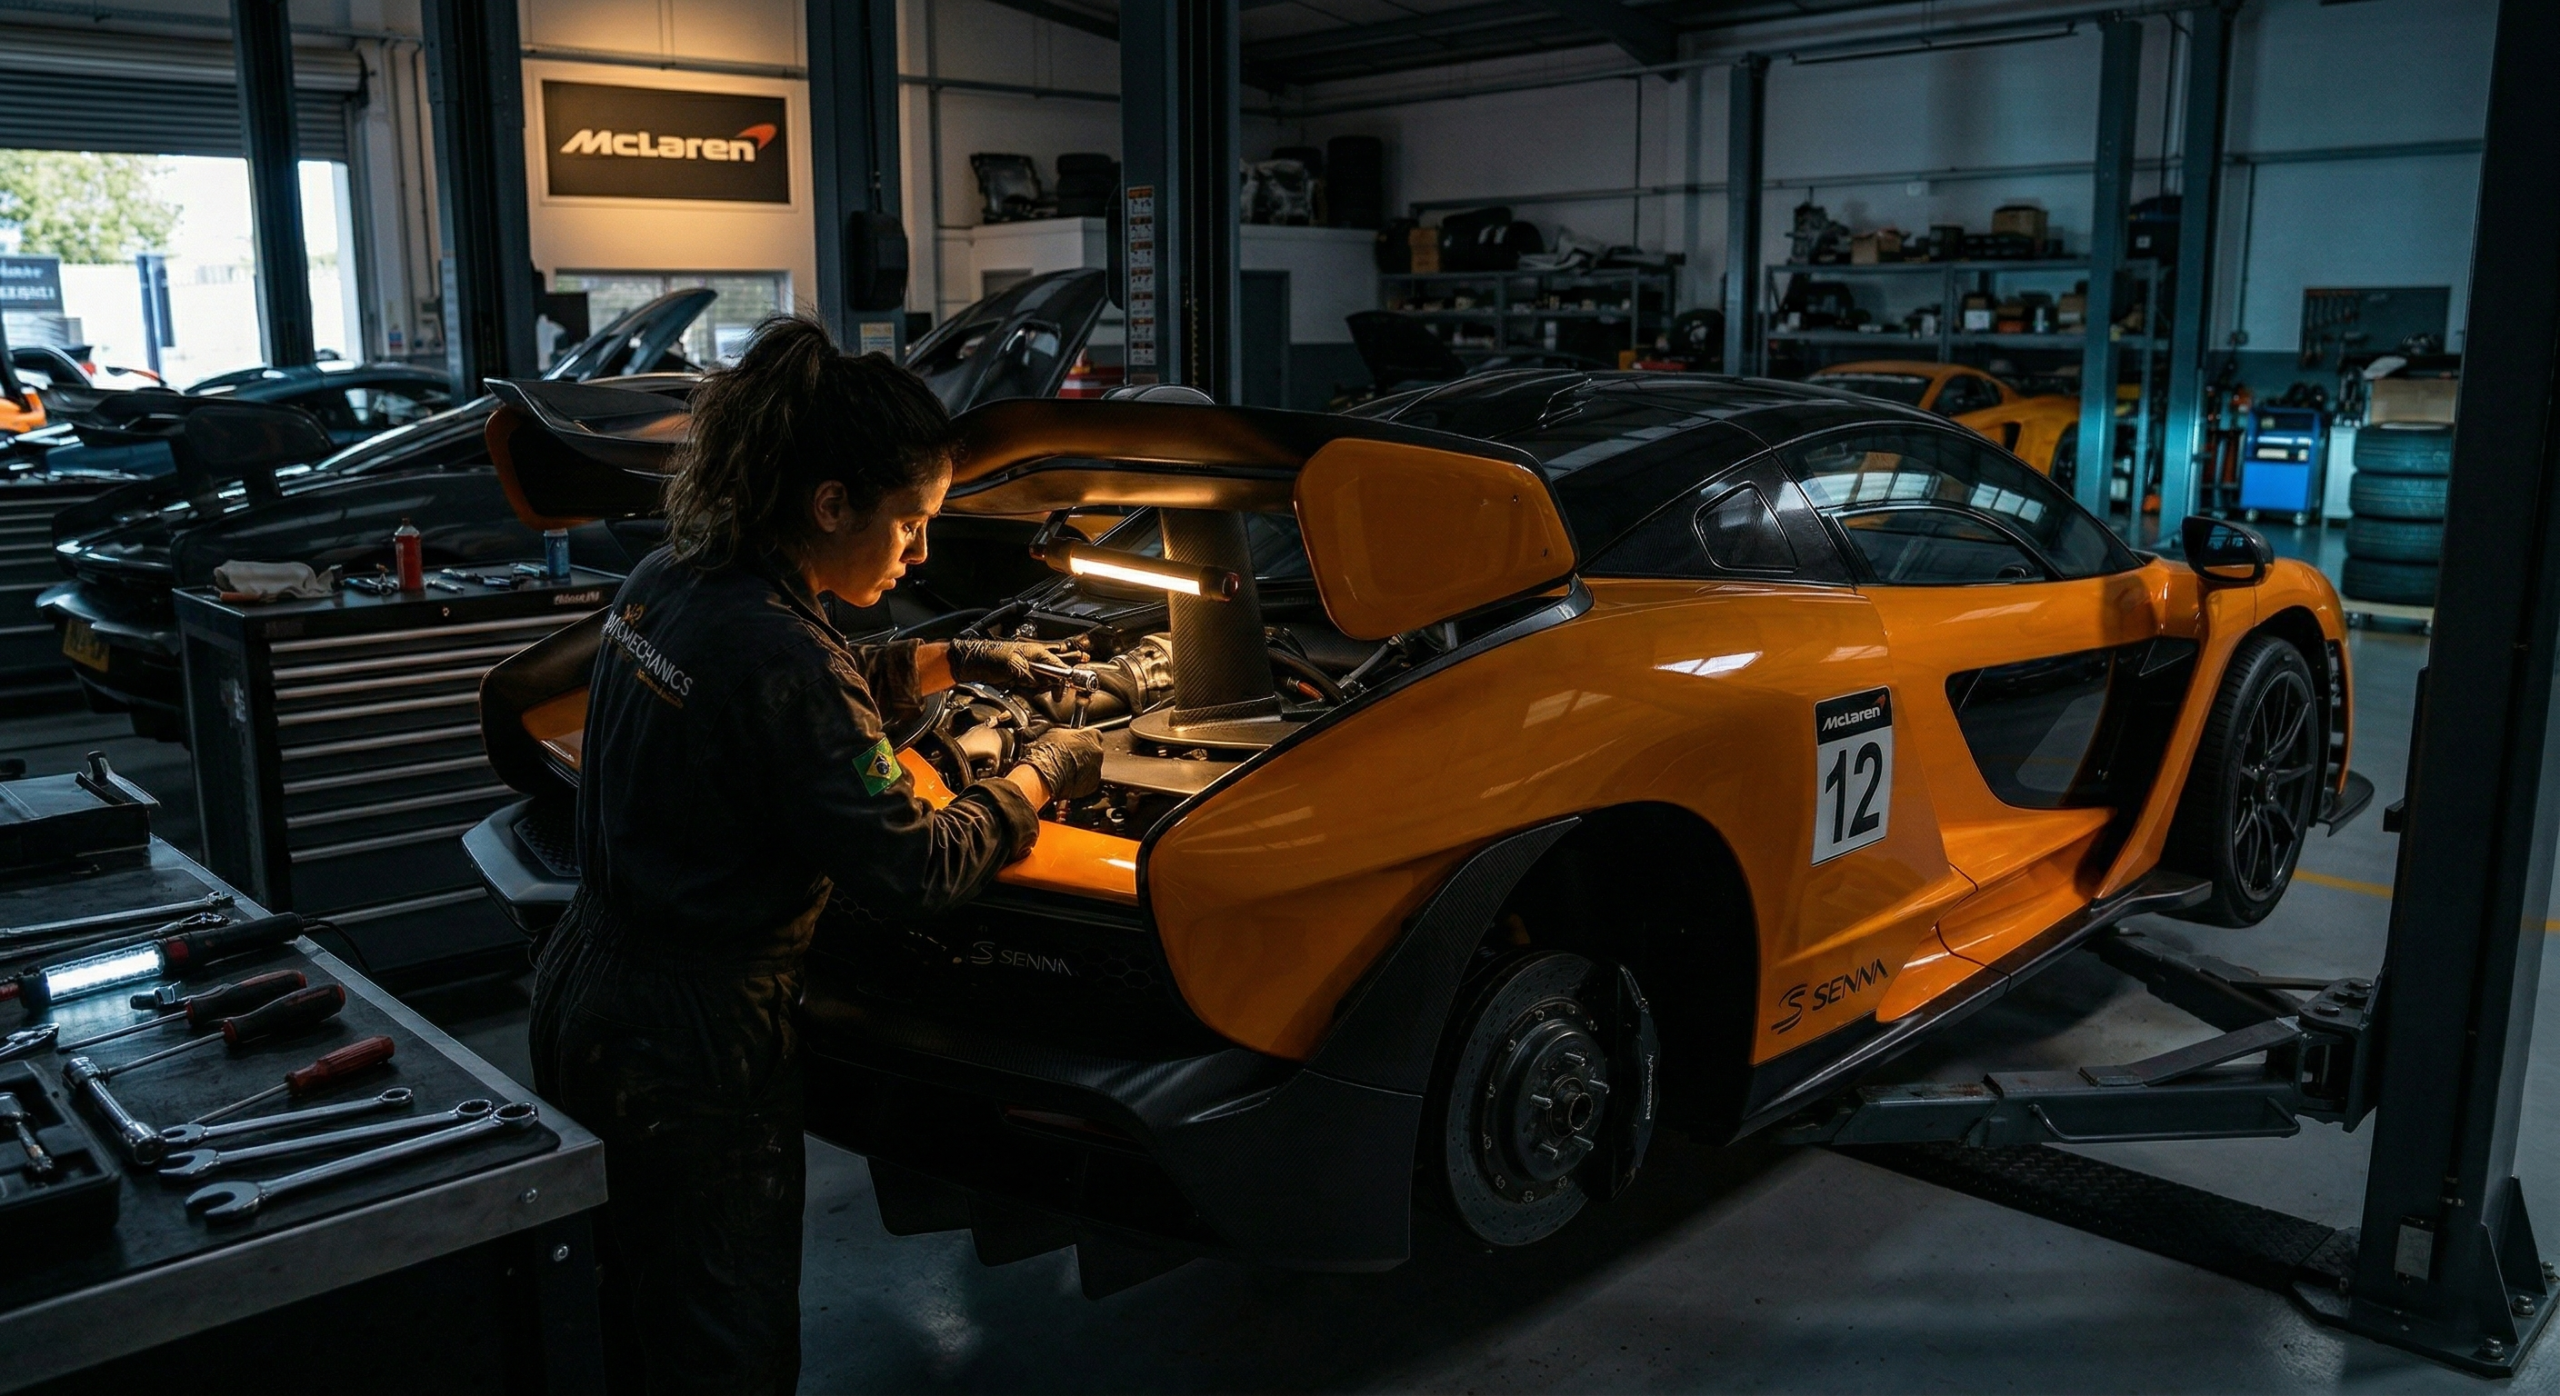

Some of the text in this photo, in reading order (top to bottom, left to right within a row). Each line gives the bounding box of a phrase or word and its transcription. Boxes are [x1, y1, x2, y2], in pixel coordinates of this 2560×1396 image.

[558, 127, 757, 163] McLaren
[1821, 705, 1882, 733] McLaren
[1824, 741, 1884, 845] 12
[998, 948, 1073, 977] SENNA
[1811, 957, 1889, 1012] SENNA
